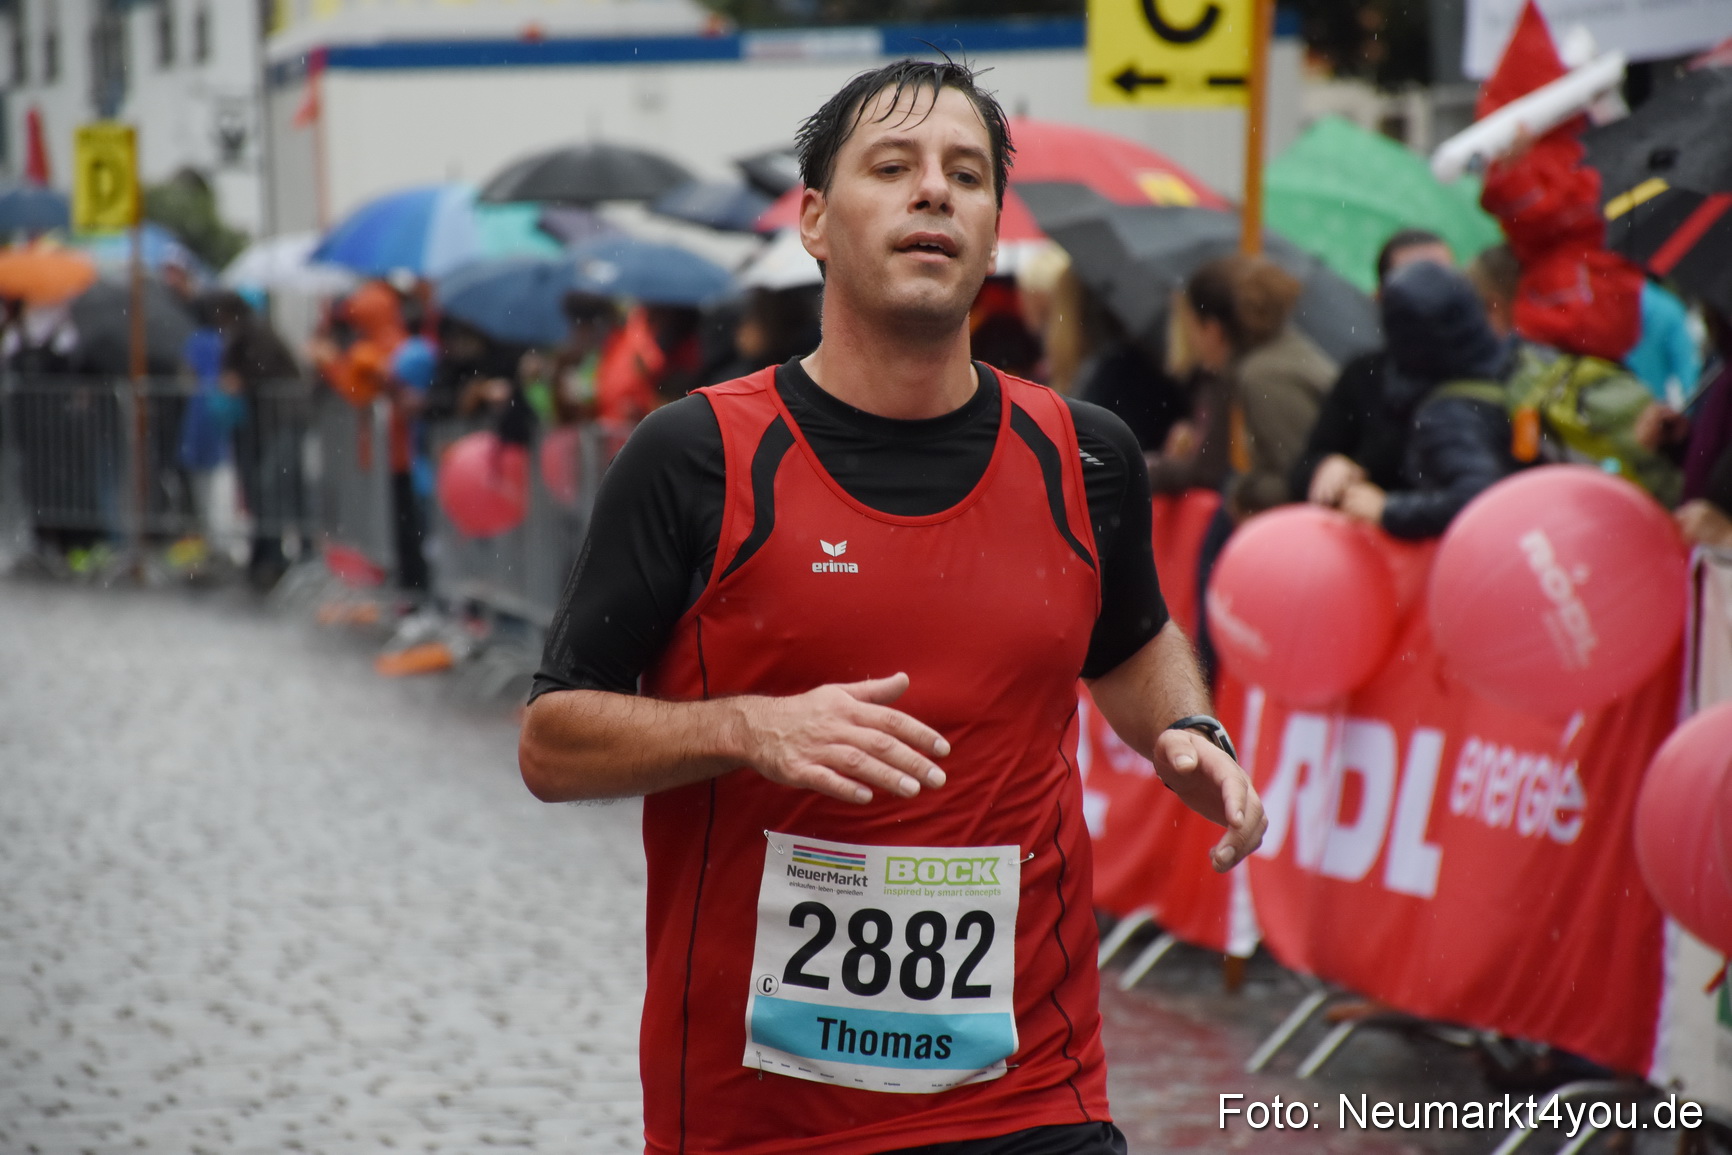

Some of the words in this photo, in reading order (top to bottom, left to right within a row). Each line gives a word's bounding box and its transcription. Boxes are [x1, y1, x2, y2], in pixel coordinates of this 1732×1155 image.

[811, 560, 859, 574] erima
[786, 864, 868, 887] NeuerMarkt
[887, 858, 999, 884] BOCK
[884, 887, 921, 897] inspired
[925, 888, 935, 898] by
[965, 888, 1001, 897] concepts
[782, 901, 995, 1001] 2882
[817, 1017, 953, 1060] Thomas
